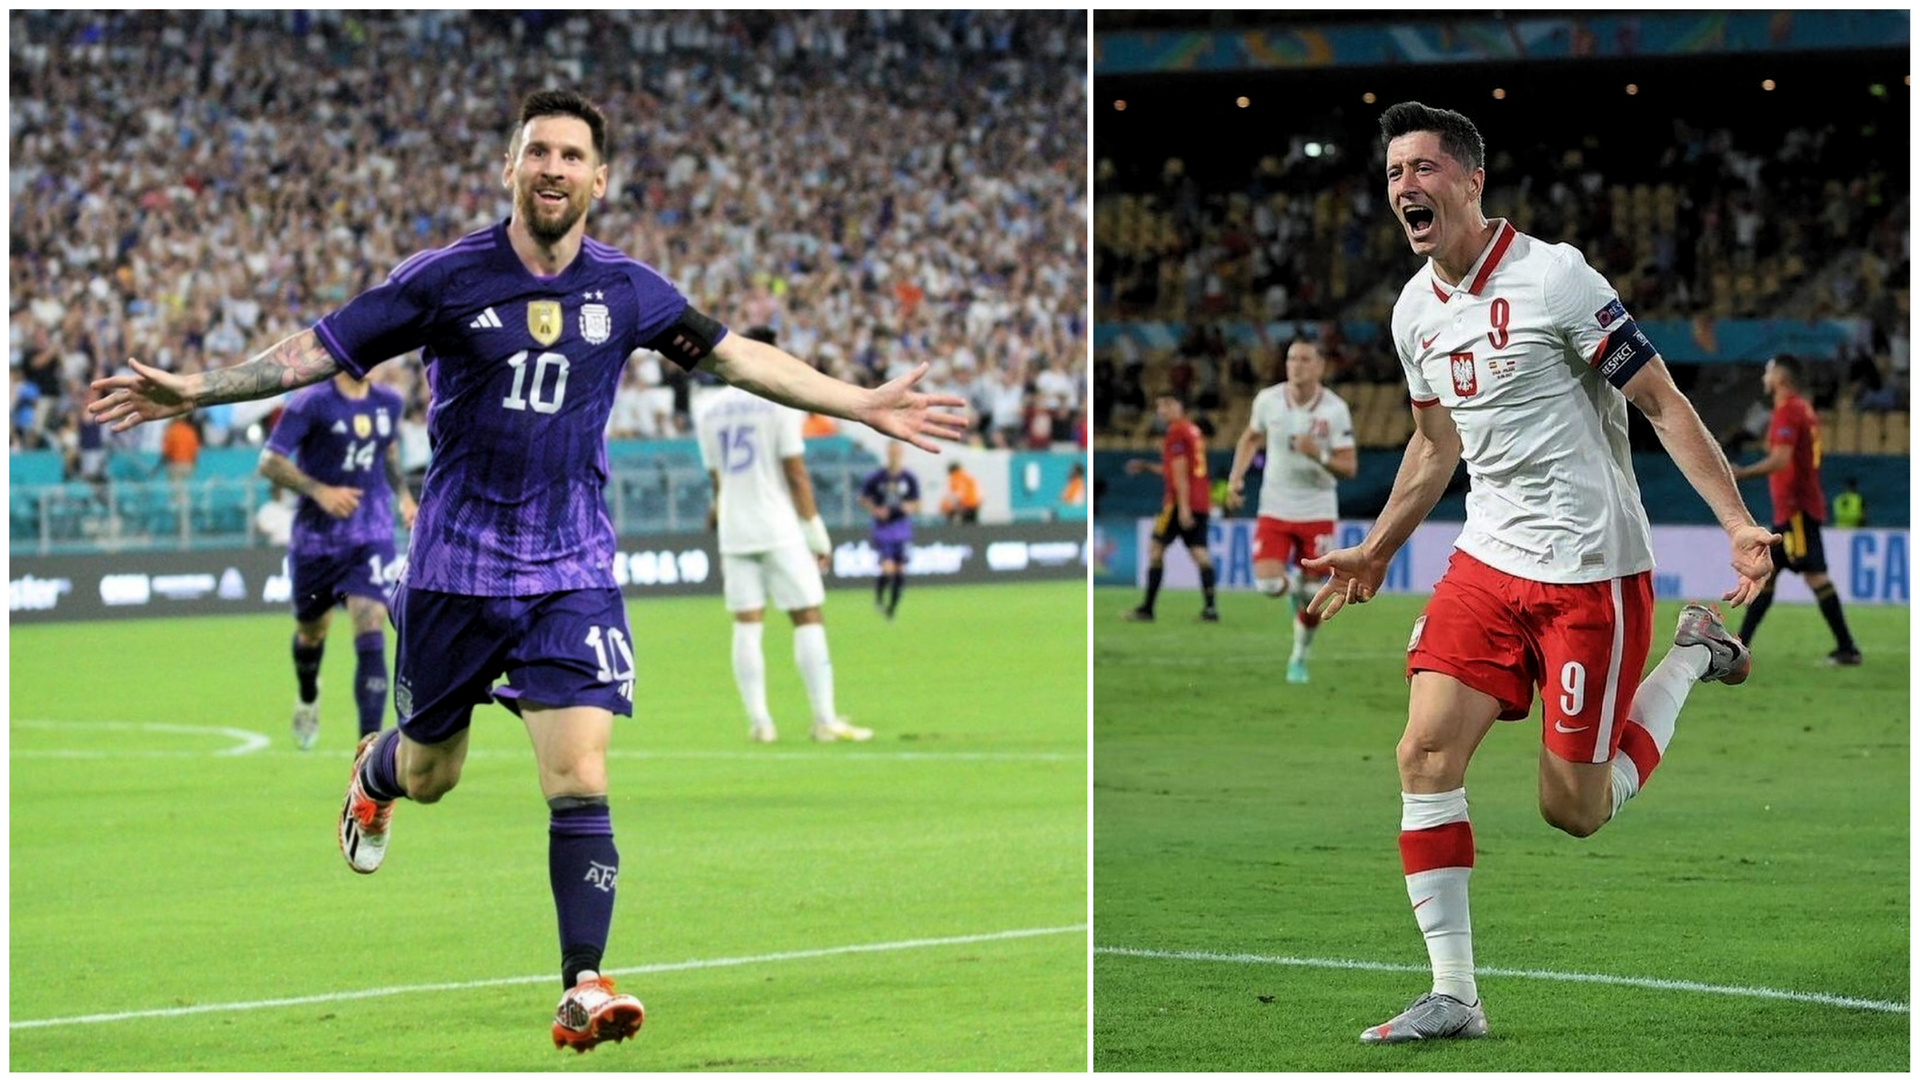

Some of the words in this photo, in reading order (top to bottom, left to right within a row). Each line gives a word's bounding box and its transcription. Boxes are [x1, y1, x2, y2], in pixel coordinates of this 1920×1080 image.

[1487, 297, 1510, 350] 9
[502, 349, 571, 414] 10
[1601, 343, 1633, 376] RESPECT
[341, 440, 377, 472] 14
[718, 423, 755, 474] 15
[584, 625, 635, 682] 10
[1560, 661, 1586, 716] 9
